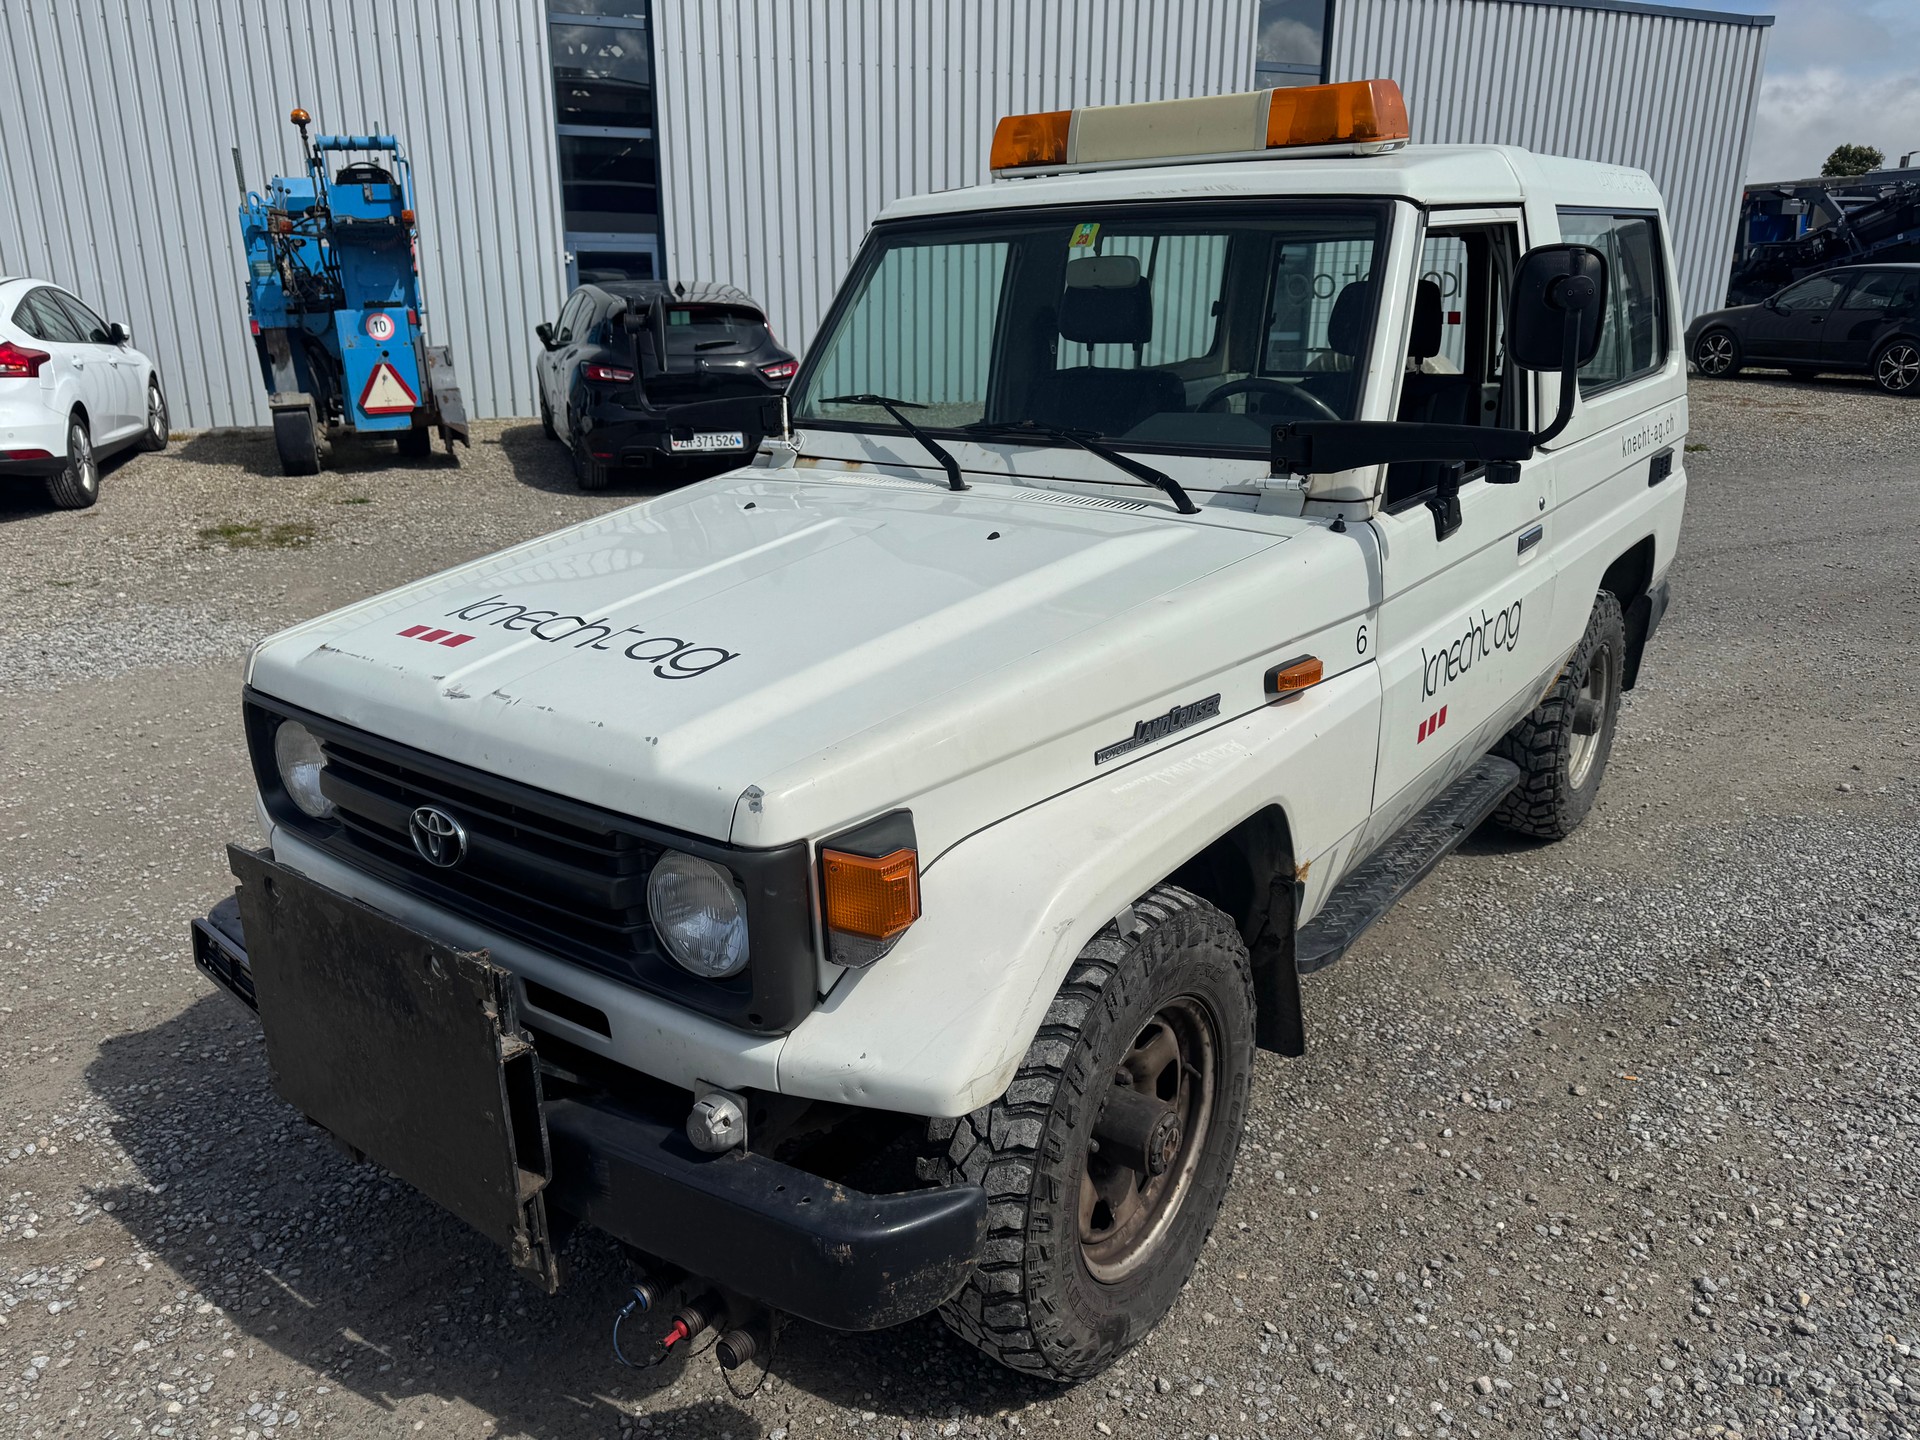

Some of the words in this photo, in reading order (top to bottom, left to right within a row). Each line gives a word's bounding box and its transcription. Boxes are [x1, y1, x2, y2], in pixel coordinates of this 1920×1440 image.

[373, 320, 386, 333] 10
[1621, 413, 1675, 458] knecht-ag.ch
[444, 594, 646, 651] knecht
[624, 637, 741, 680] ag
[1356, 624, 1368, 655] 6
[1421, 609, 1494, 703] knecht
[1493, 598, 1523, 652] ag
